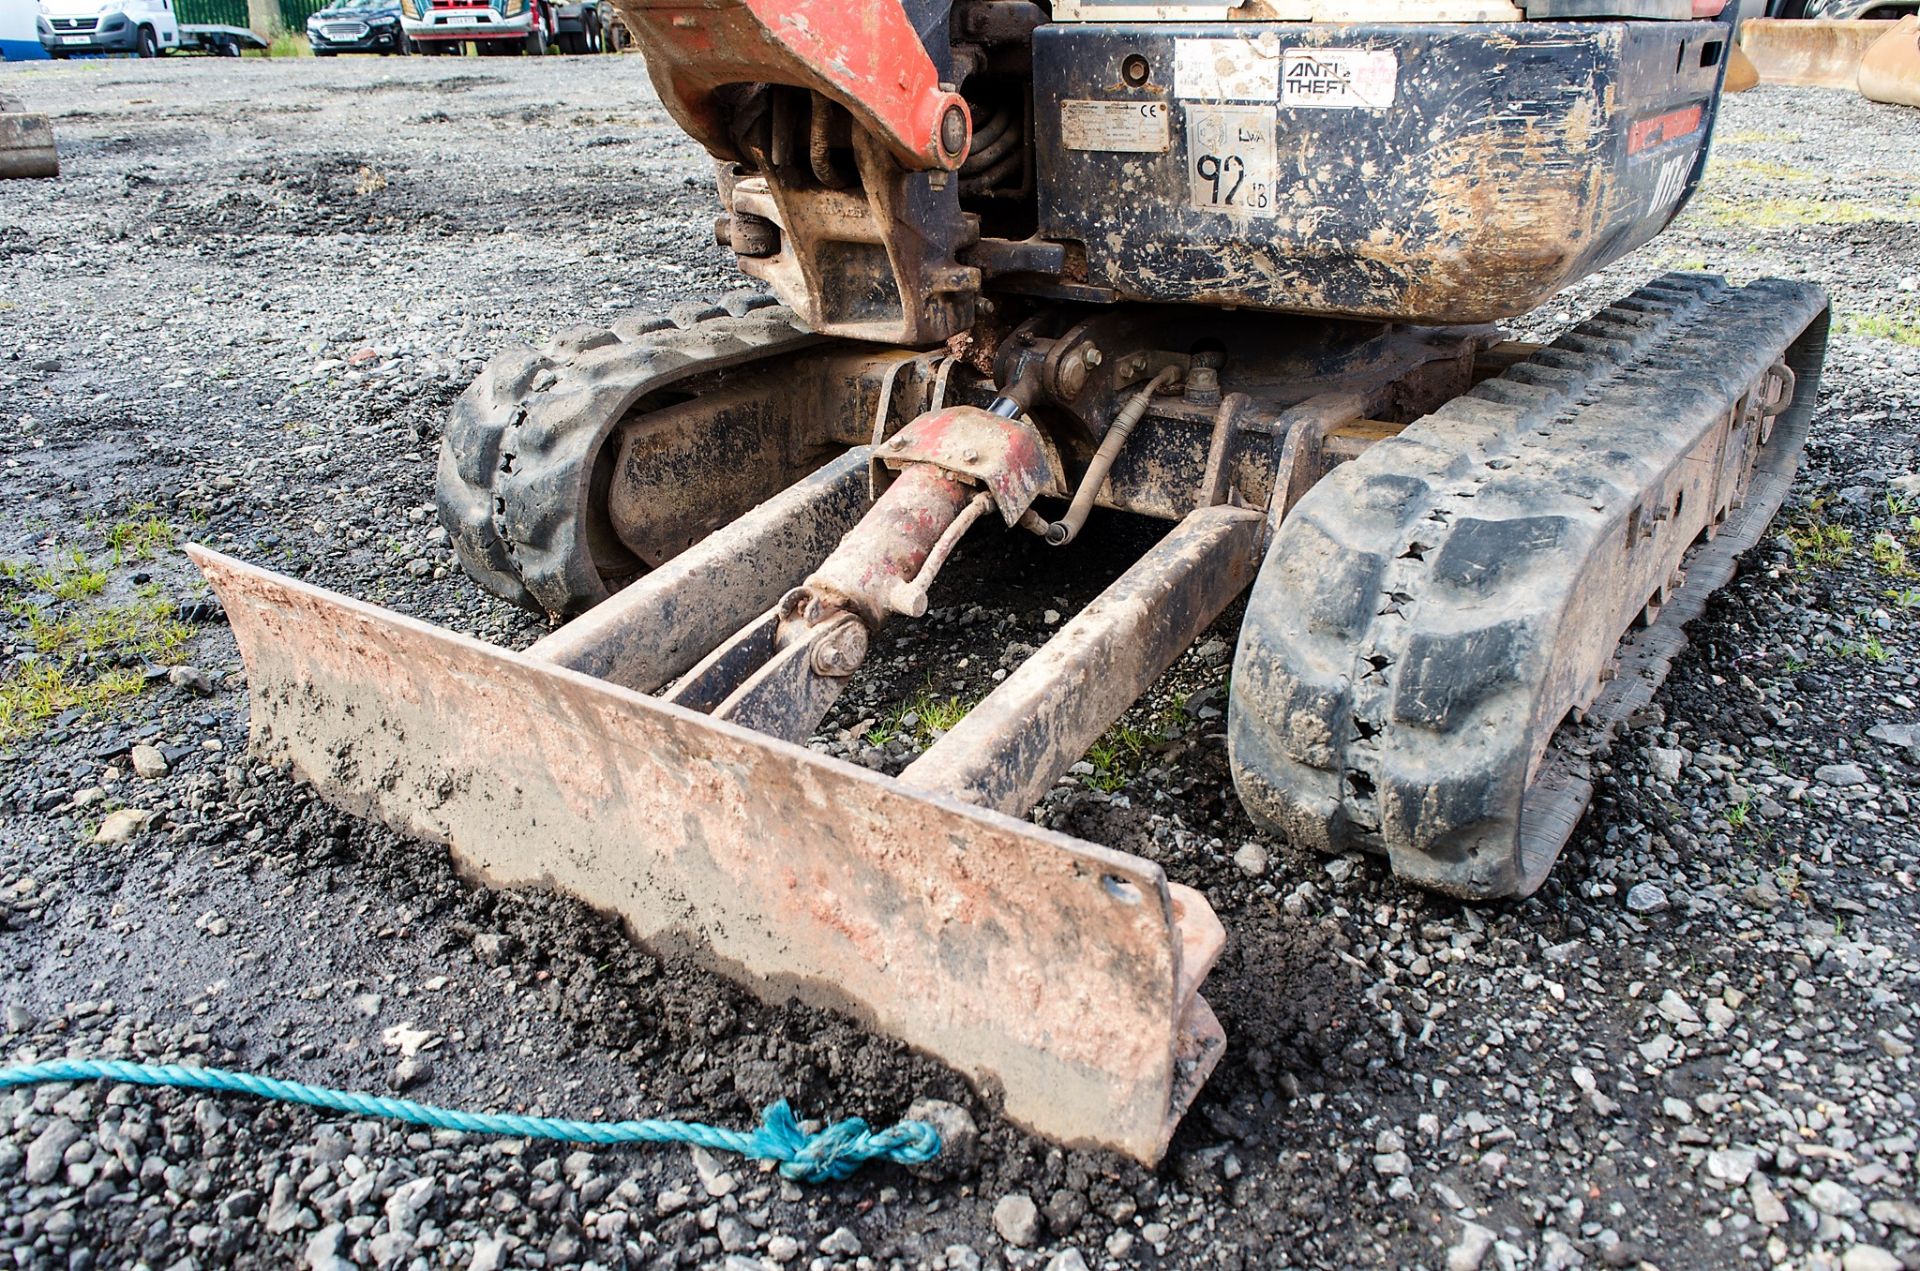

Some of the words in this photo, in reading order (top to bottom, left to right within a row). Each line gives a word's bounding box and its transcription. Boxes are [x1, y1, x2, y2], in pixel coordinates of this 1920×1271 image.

[1287, 62, 1338, 77] ANTI
[1286, 79, 1351, 95] THEFT
[1140, 104, 1157, 118] CE
[1196, 154, 1245, 206] 92
